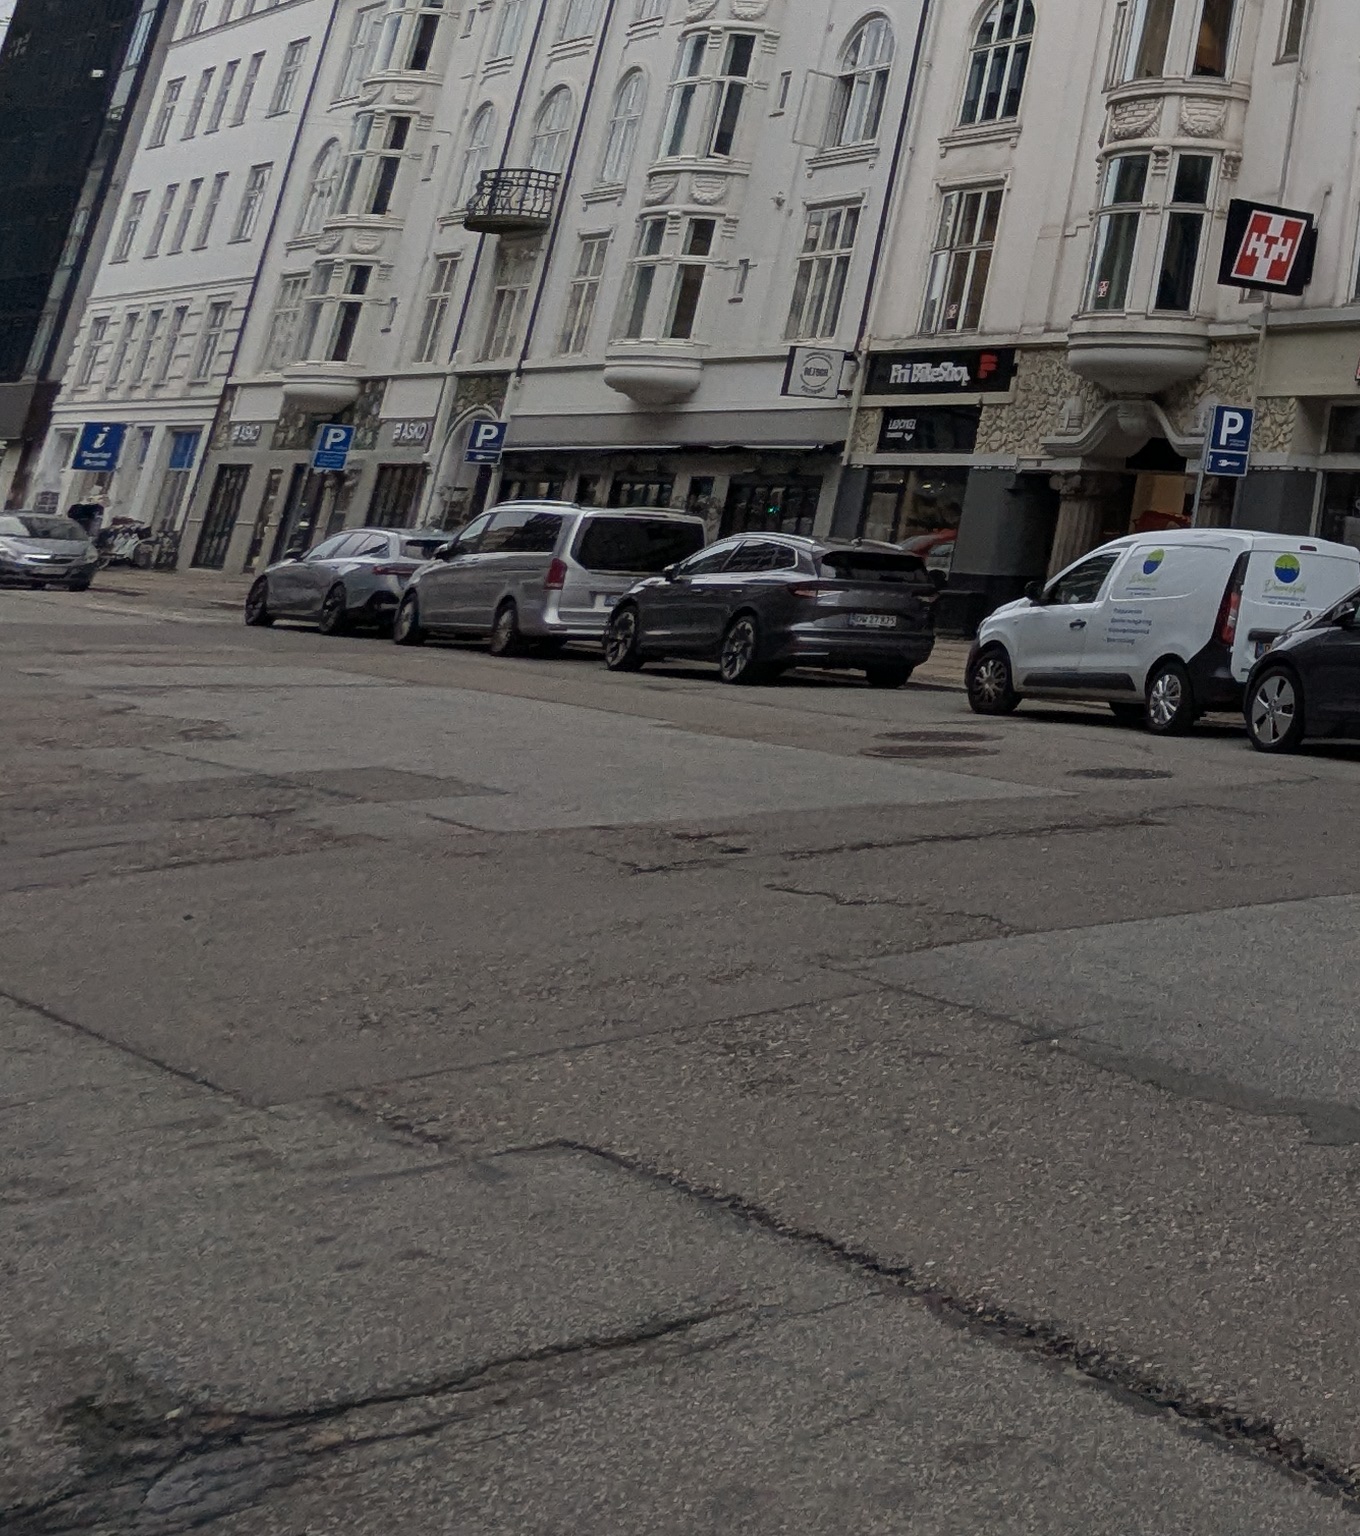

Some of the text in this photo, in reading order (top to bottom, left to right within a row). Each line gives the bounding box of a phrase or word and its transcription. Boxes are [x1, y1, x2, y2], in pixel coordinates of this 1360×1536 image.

[1246, 232, 1293, 262] HTH
[889, 364, 911, 383] Fri
[324, 429, 346, 449] P
[476, 425, 499, 447] P
[1220, 411, 1244, 445] P
